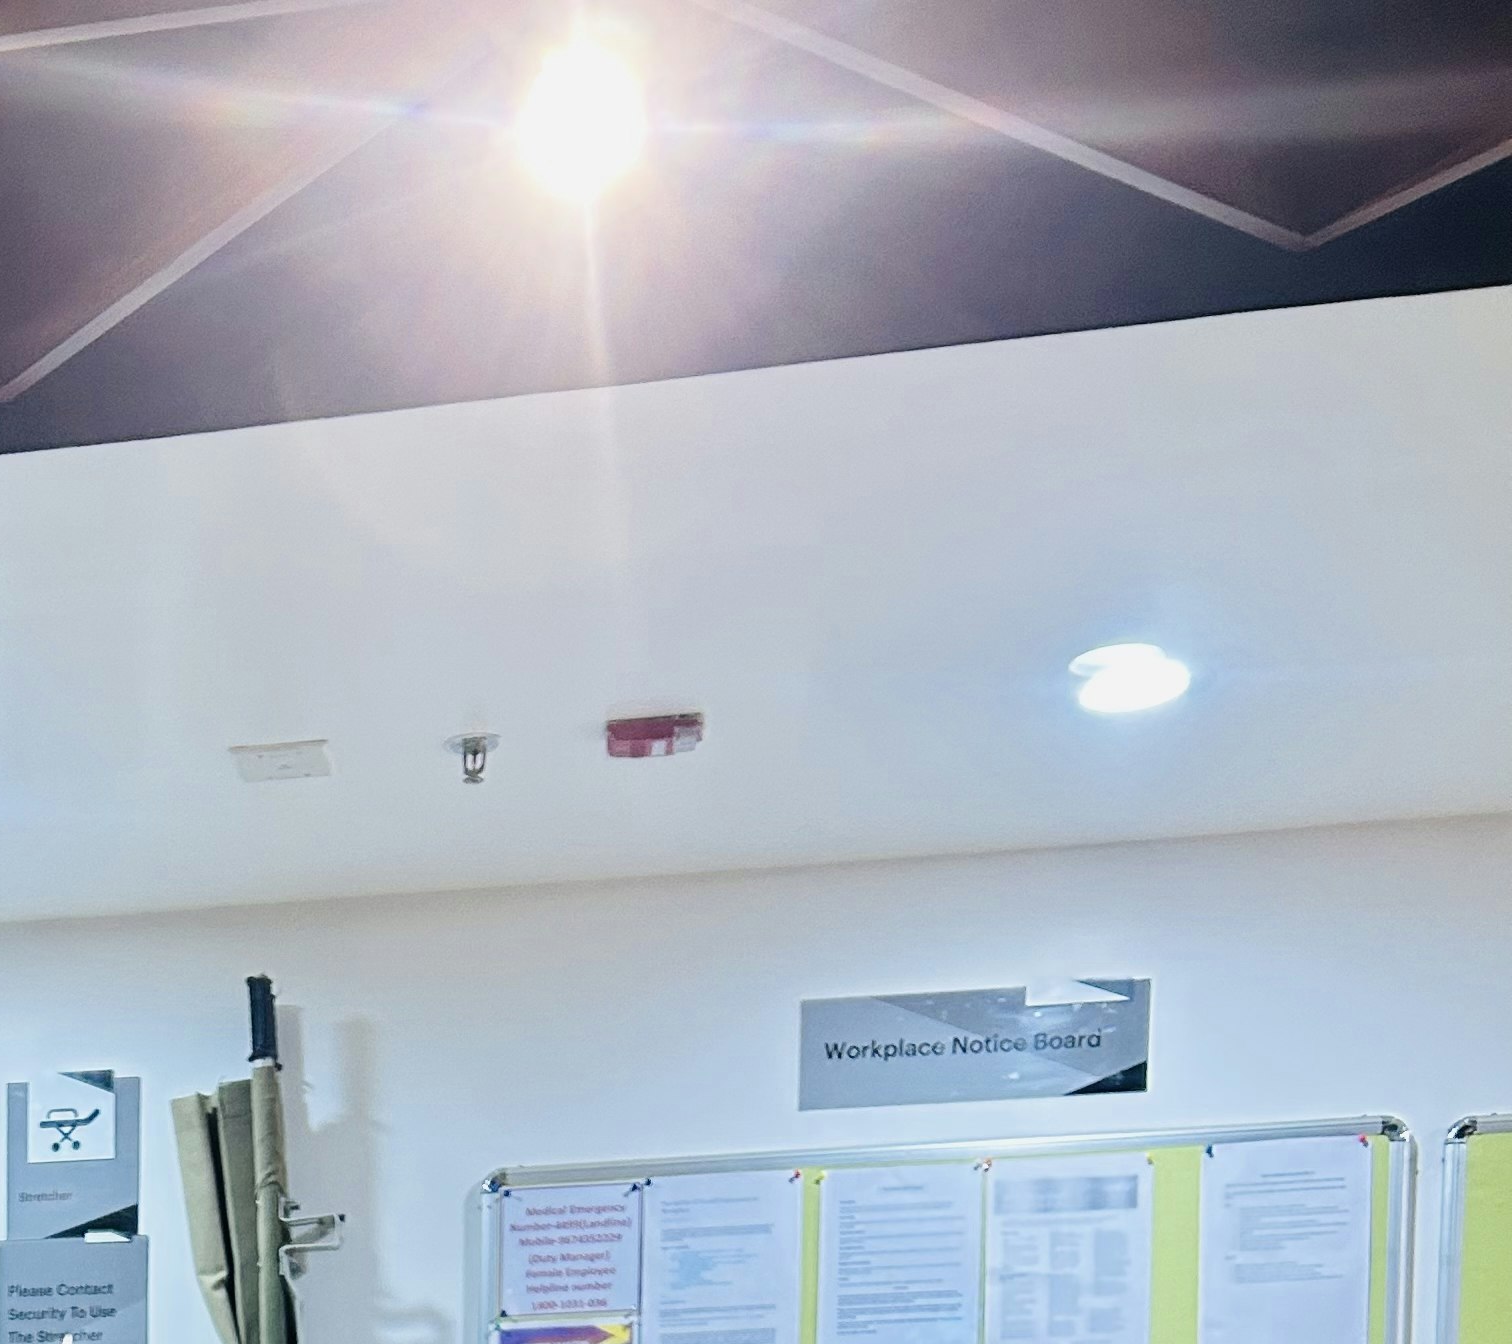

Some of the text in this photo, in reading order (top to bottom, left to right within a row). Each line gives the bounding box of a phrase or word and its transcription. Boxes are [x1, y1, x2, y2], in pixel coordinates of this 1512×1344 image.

[824, 1027, 1103, 1063] Workplace Notice Board
[526, 1204, 625, 1217] Medical Emergency
[7, 1281, 115, 1299] Please Contact
[7, 1304, 118, 1323] Security To Use
[8, 1330, 34, 1344] The
